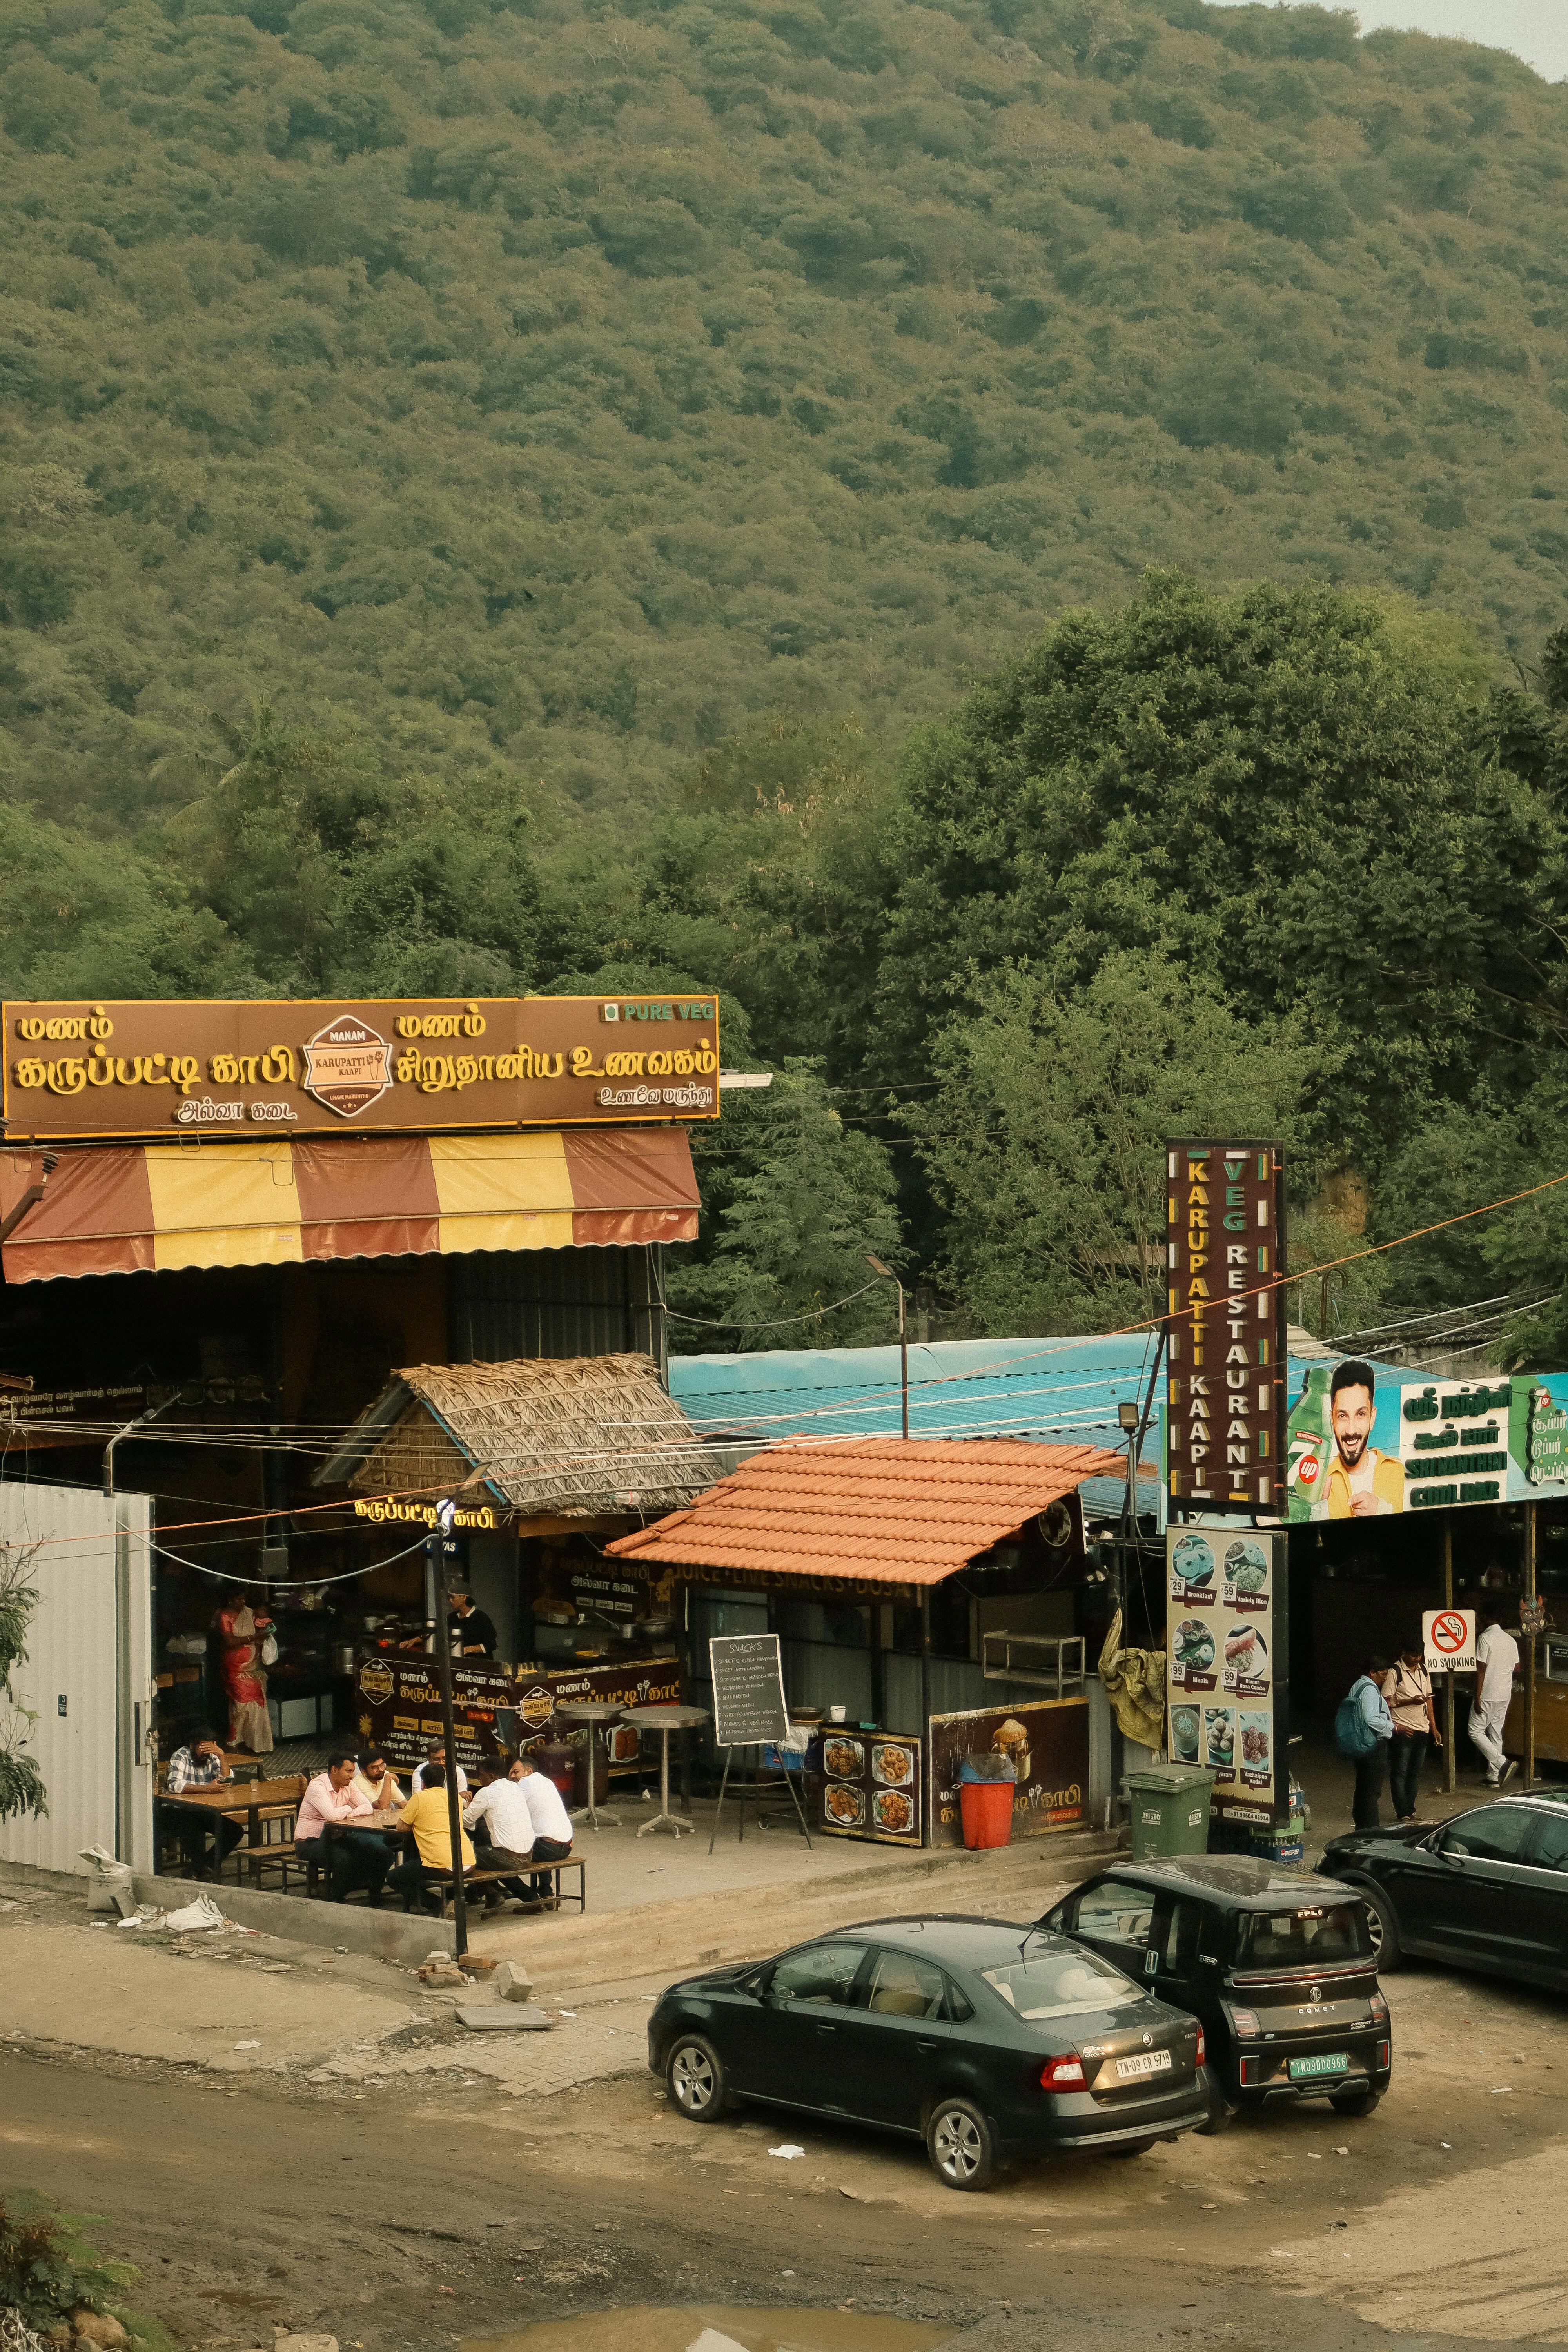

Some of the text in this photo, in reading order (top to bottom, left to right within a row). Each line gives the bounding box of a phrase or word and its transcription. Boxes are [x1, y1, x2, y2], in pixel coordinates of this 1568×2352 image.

[624, 1002, 715, 1020] PURE VEG
[19, 1005, 114, 1040] மணம்
[399, 1002, 487, 1038] மணம்
[330, 1031, 366, 1042] MANAM
[16, 1043, 296, 1095] கருப்பட்டி காபி
[315, 1057, 365, 1068] KARUPATTI
[397, 1044, 564, 1093] சிறுதானிய
[600, 1081, 713, 1108] உணவே மருந்து
[177, 1096, 298, 1123] அல்வா கடை
[1223, 1162, 1246, 1231] VEG
[1187, 1162, 1210, 1365] KARUPATTI
[1225, 1245, 1251, 1488] RESTAURANT
[1189, 1375, 1211, 1487] KAAPI
[354, 1496, 495, 1529] கருப்பட்டி காபி
[1187, 1591, 1213, 1600] Breakfast
[1237, 1596, 1255, 1605] Variety
[729, 1642, 763, 1653] SNACKS
[1427, 1657, 1475, 1668] NO SMOKING
[400, 1671, 428, 1683] மணம்
[455, 1670, 487, 1684] அல்வா
[557, 1678, 591, 1694] மணம்
[1244, 1771, 1268, 1780] Vazhaipoo
[1041, 1784, 1081, 1808] காபி
[1150, 1812, 1168, 1821] ARISTO
[1189, 1811, 1202, 1822] ARISTO
[1284, 1848, 1299, 1857] PEPSI
[1298, 2005, 1336, 2014] COMET
[1143, 2057, 1152, 2069] CR
